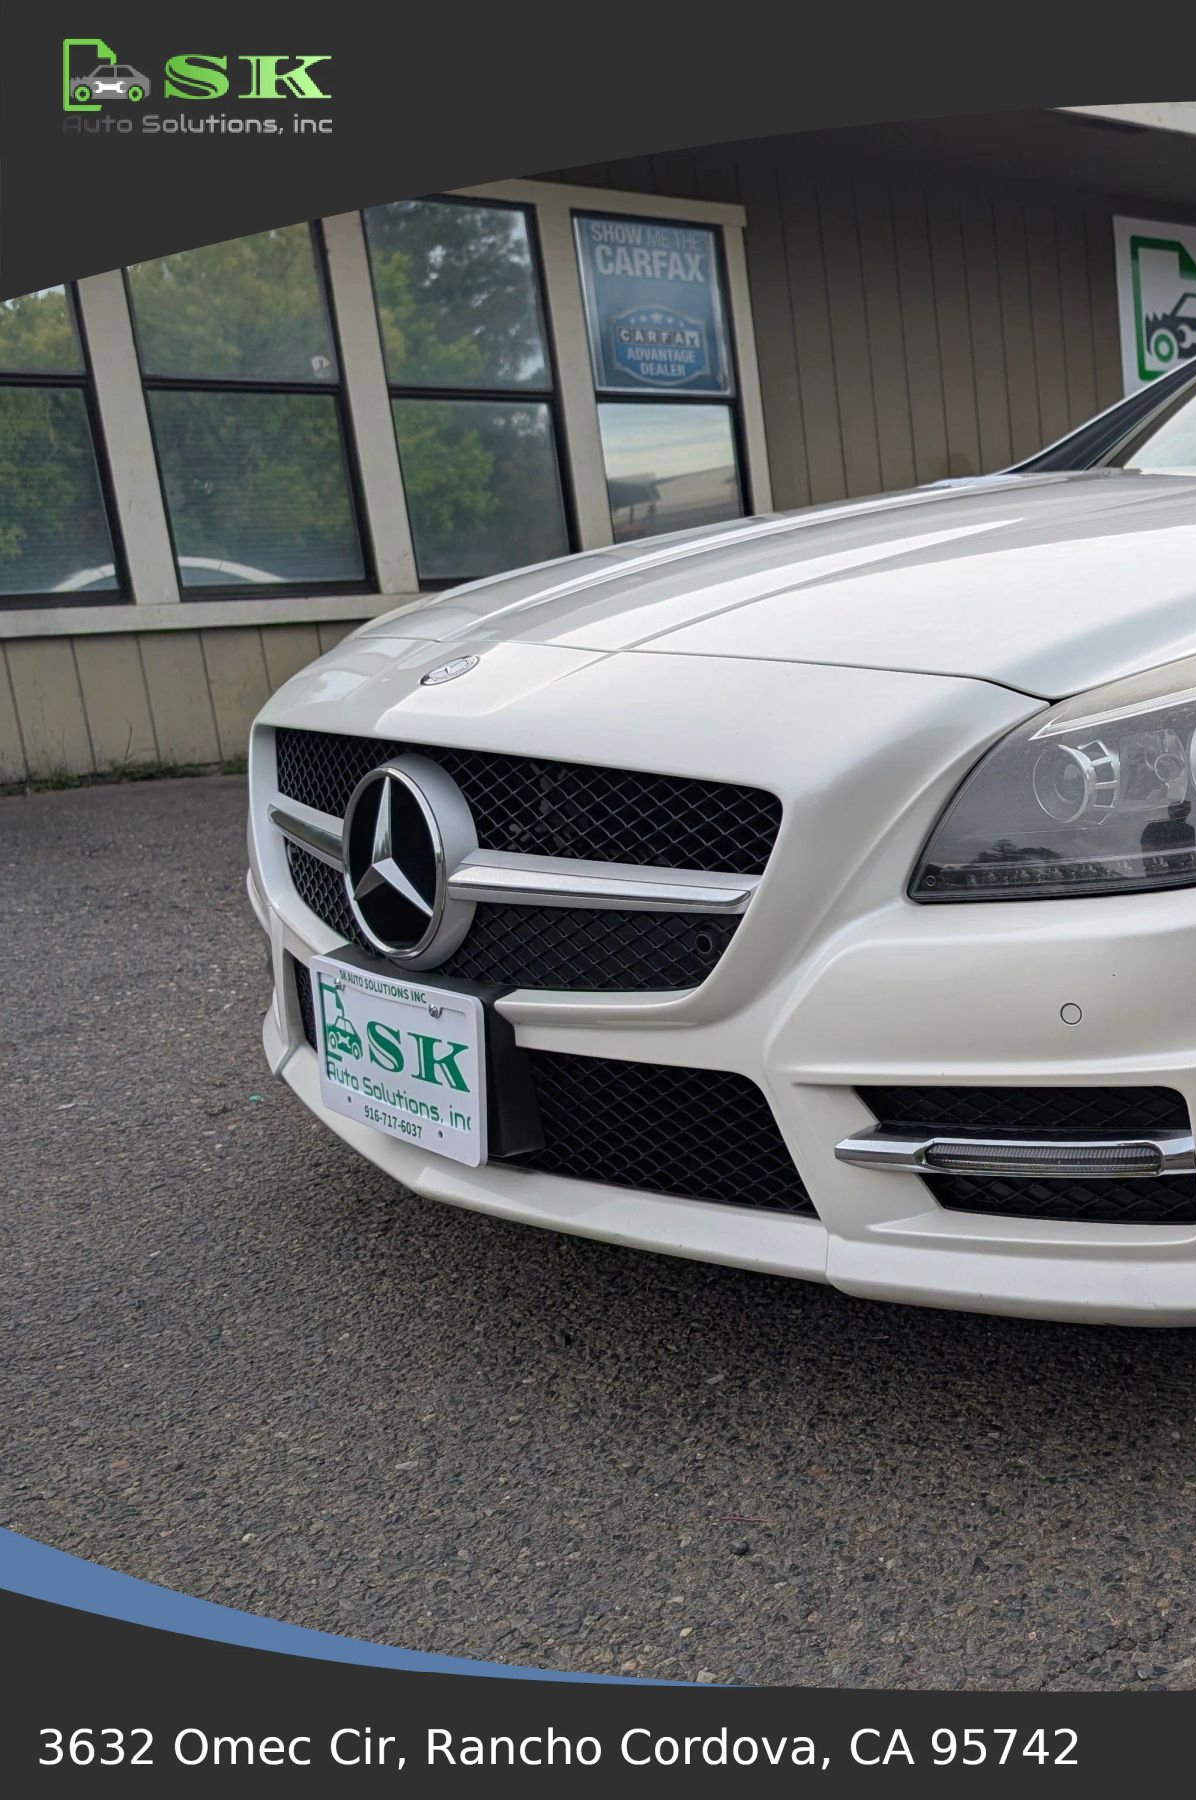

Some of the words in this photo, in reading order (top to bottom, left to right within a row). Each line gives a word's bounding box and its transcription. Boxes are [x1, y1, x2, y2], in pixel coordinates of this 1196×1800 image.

[591, 222, 642, 245] SHOW
[647, 229, 670, 248] ME
[675, 231, 701, 250] THE
[595, 244, 705, 282] CARFAX
[619, 328, 700, 348] CARFAX
[626, 347, 696, 363] ADVANTAGE
[640, 362, 687, 377] DEALER
[348, 971, 363, 987] AUTO
[364, 977, 410, 1000] SOLUTIONS
[411, 989, 427, 1004] INC
[366, 1020, 471, 1093] SK
[327, 1059, 359, 1091] Auto
[362, 1076, 444, 1124] Solutions,
[364, 1105, 423, 1139] 916-717-6037
